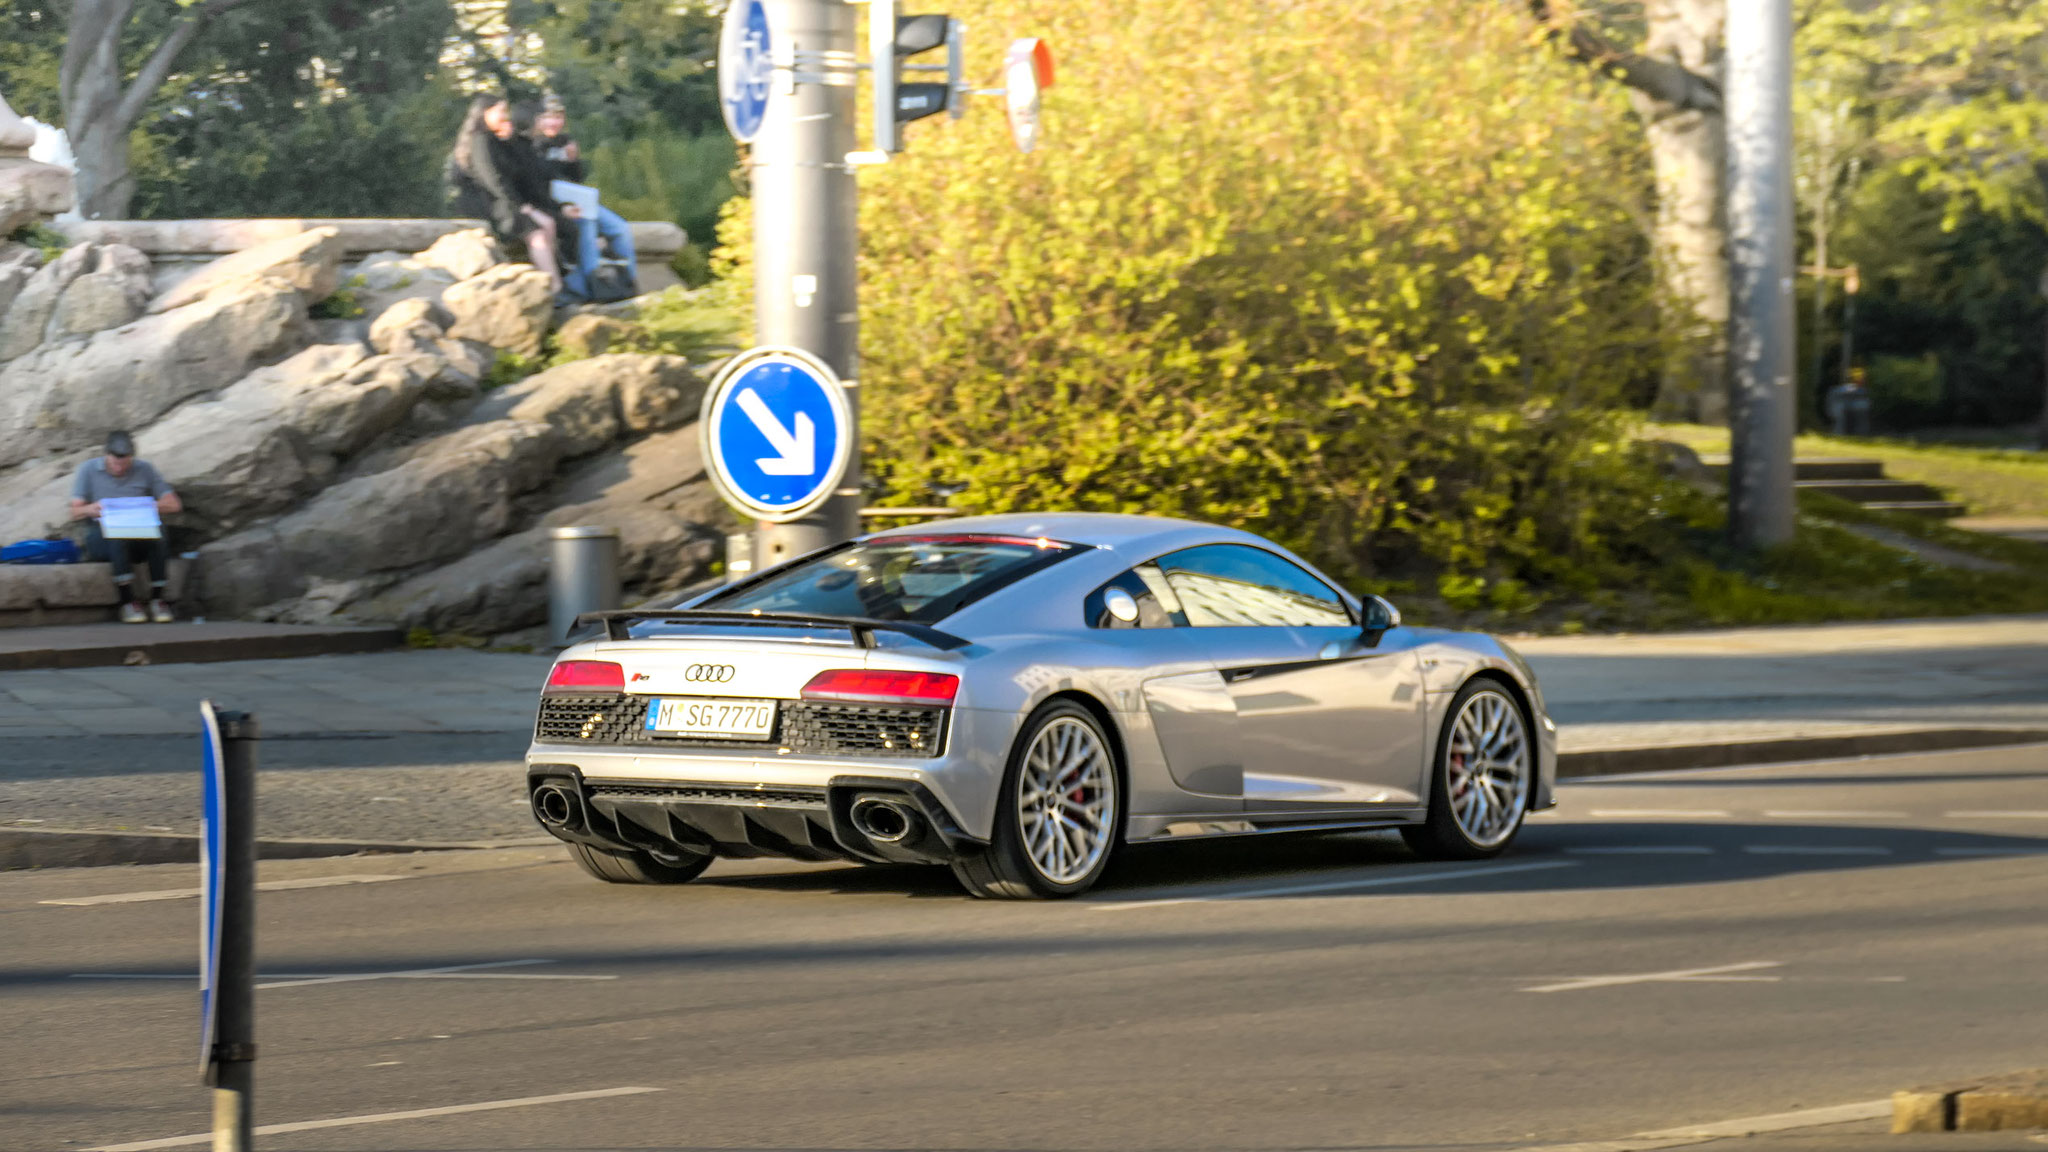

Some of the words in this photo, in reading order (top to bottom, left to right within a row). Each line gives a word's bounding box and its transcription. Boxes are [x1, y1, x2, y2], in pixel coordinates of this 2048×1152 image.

[658, 703, 674, 726] M
[686, 704, 713, 726] SG
[718, 706, 769, 729] 7770
